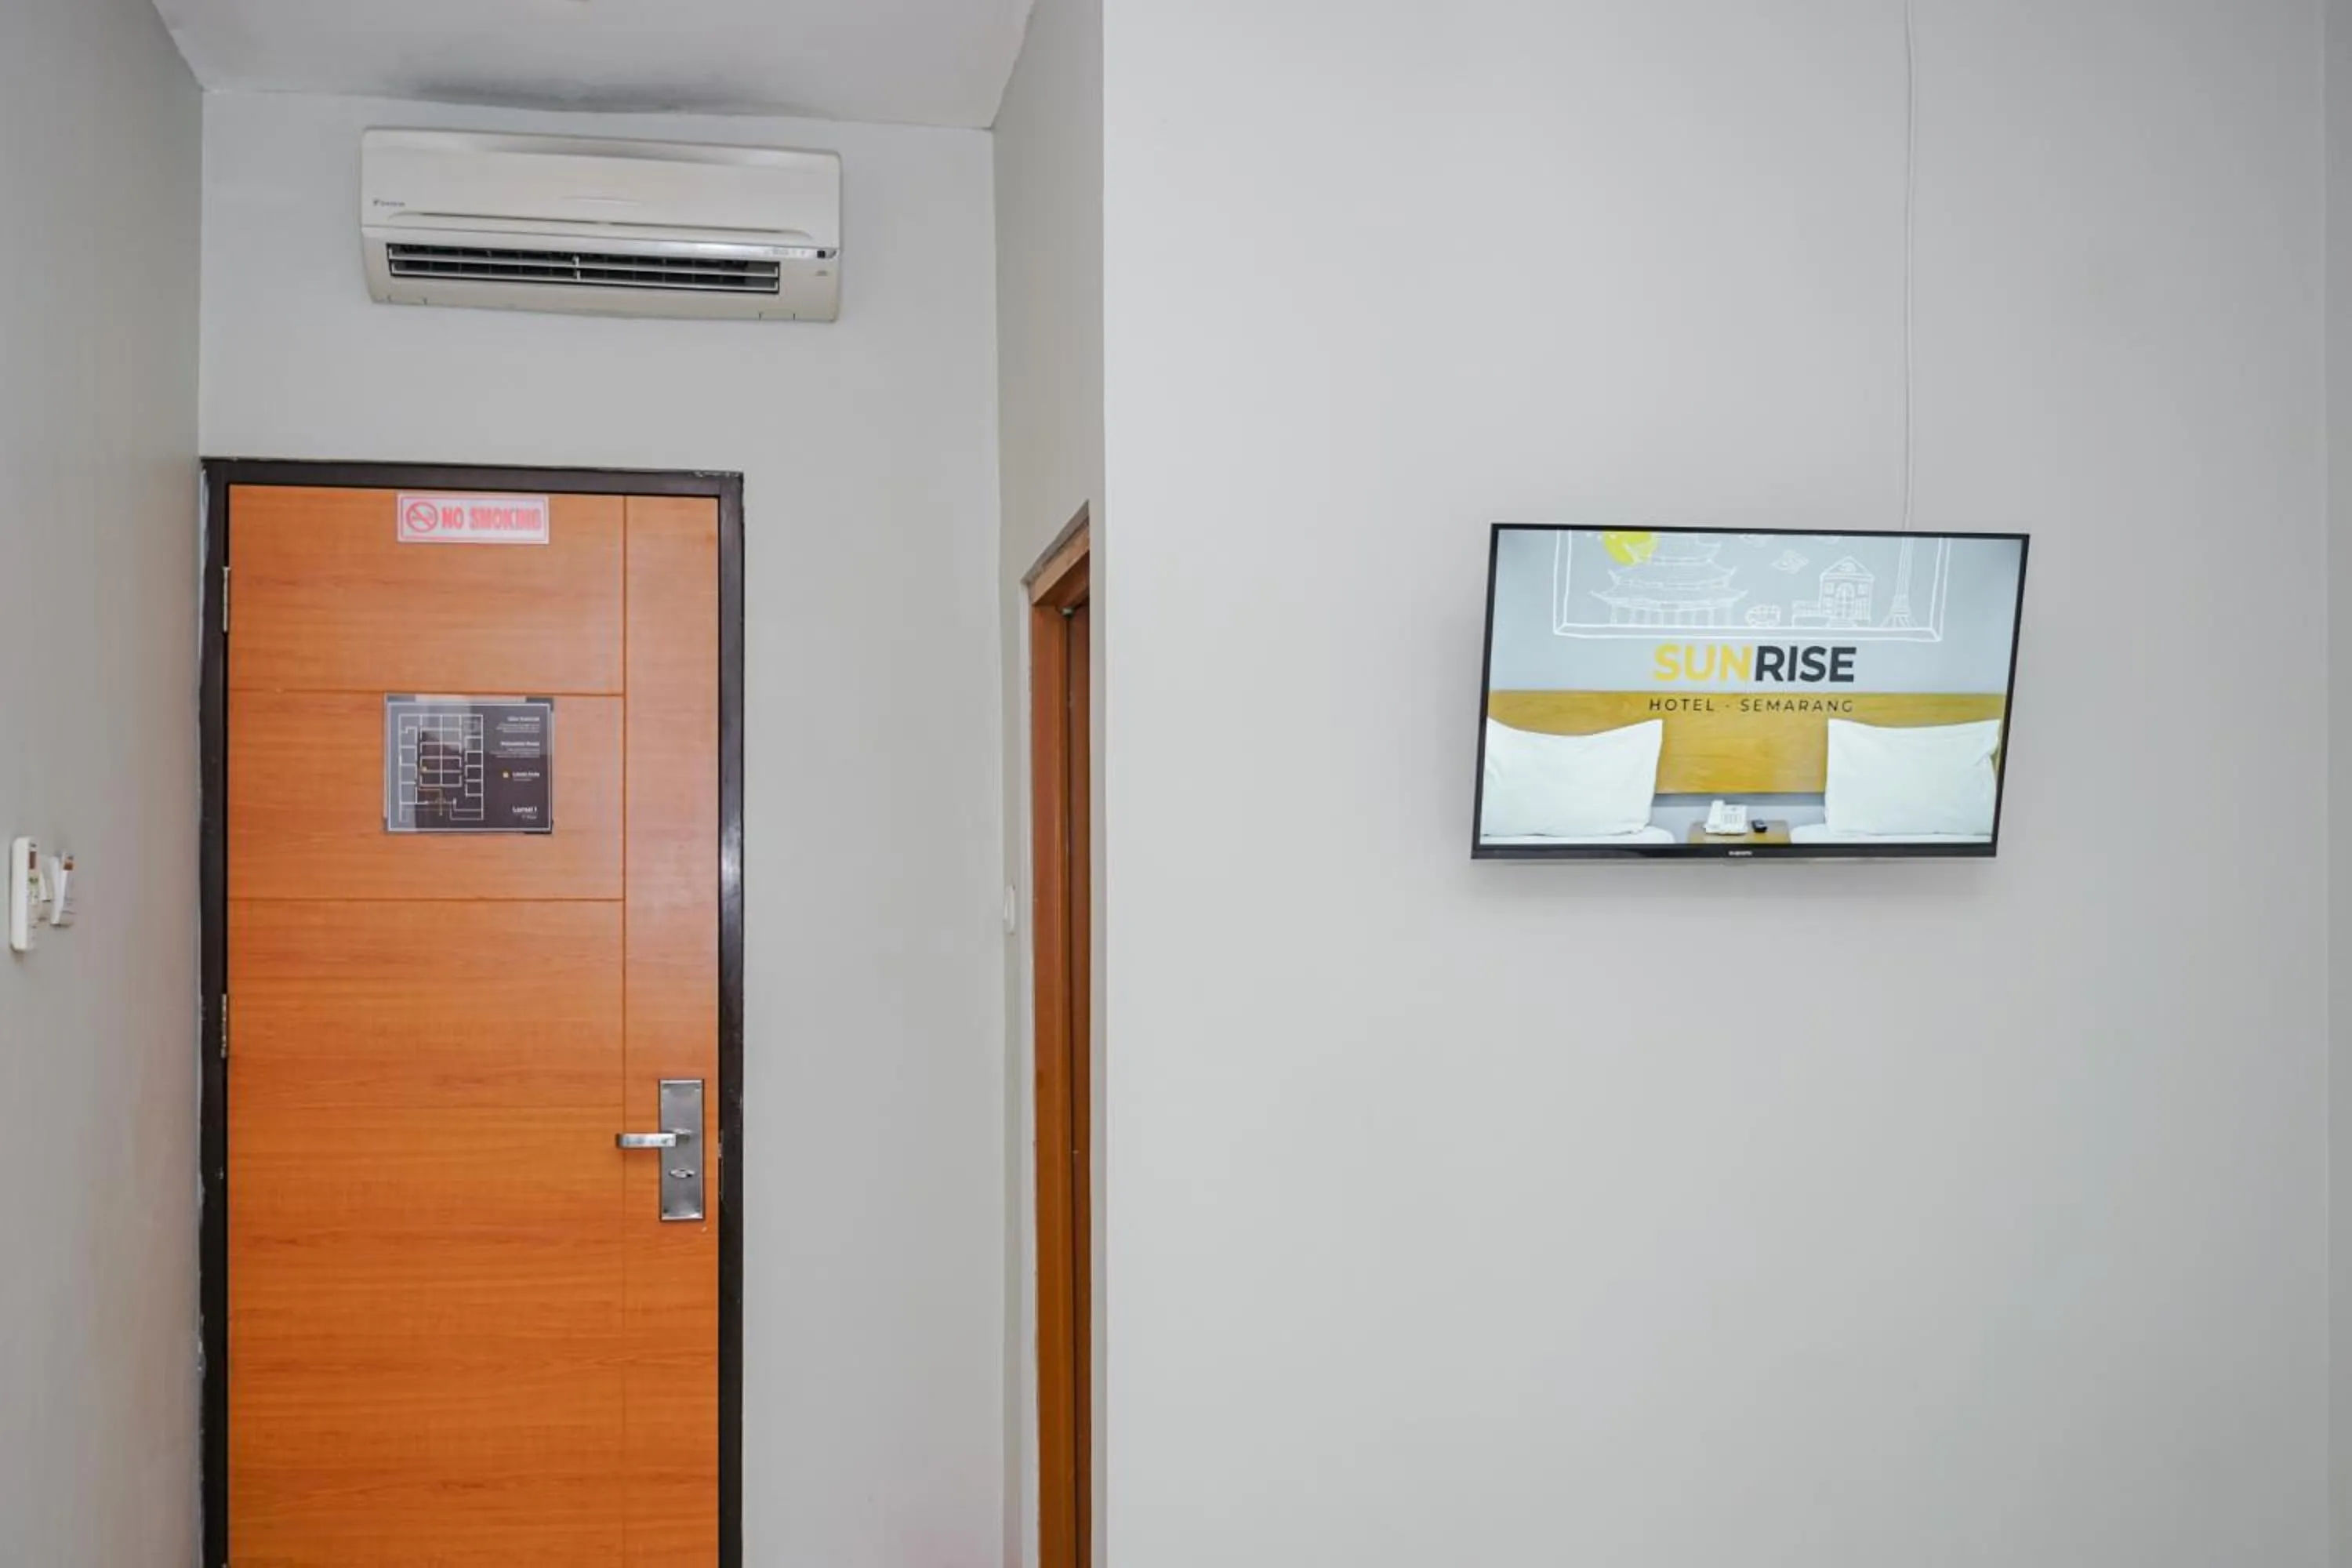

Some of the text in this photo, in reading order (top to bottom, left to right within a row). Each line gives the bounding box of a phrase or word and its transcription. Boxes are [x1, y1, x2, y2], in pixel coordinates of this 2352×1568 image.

[441, 506, 464, 529] NO
[1653, 643, 1857, 683] SUNRISE
[1649, 698, 1715, 712] HOTEL
[1740, 699, 1854, 713] SEMARANG
